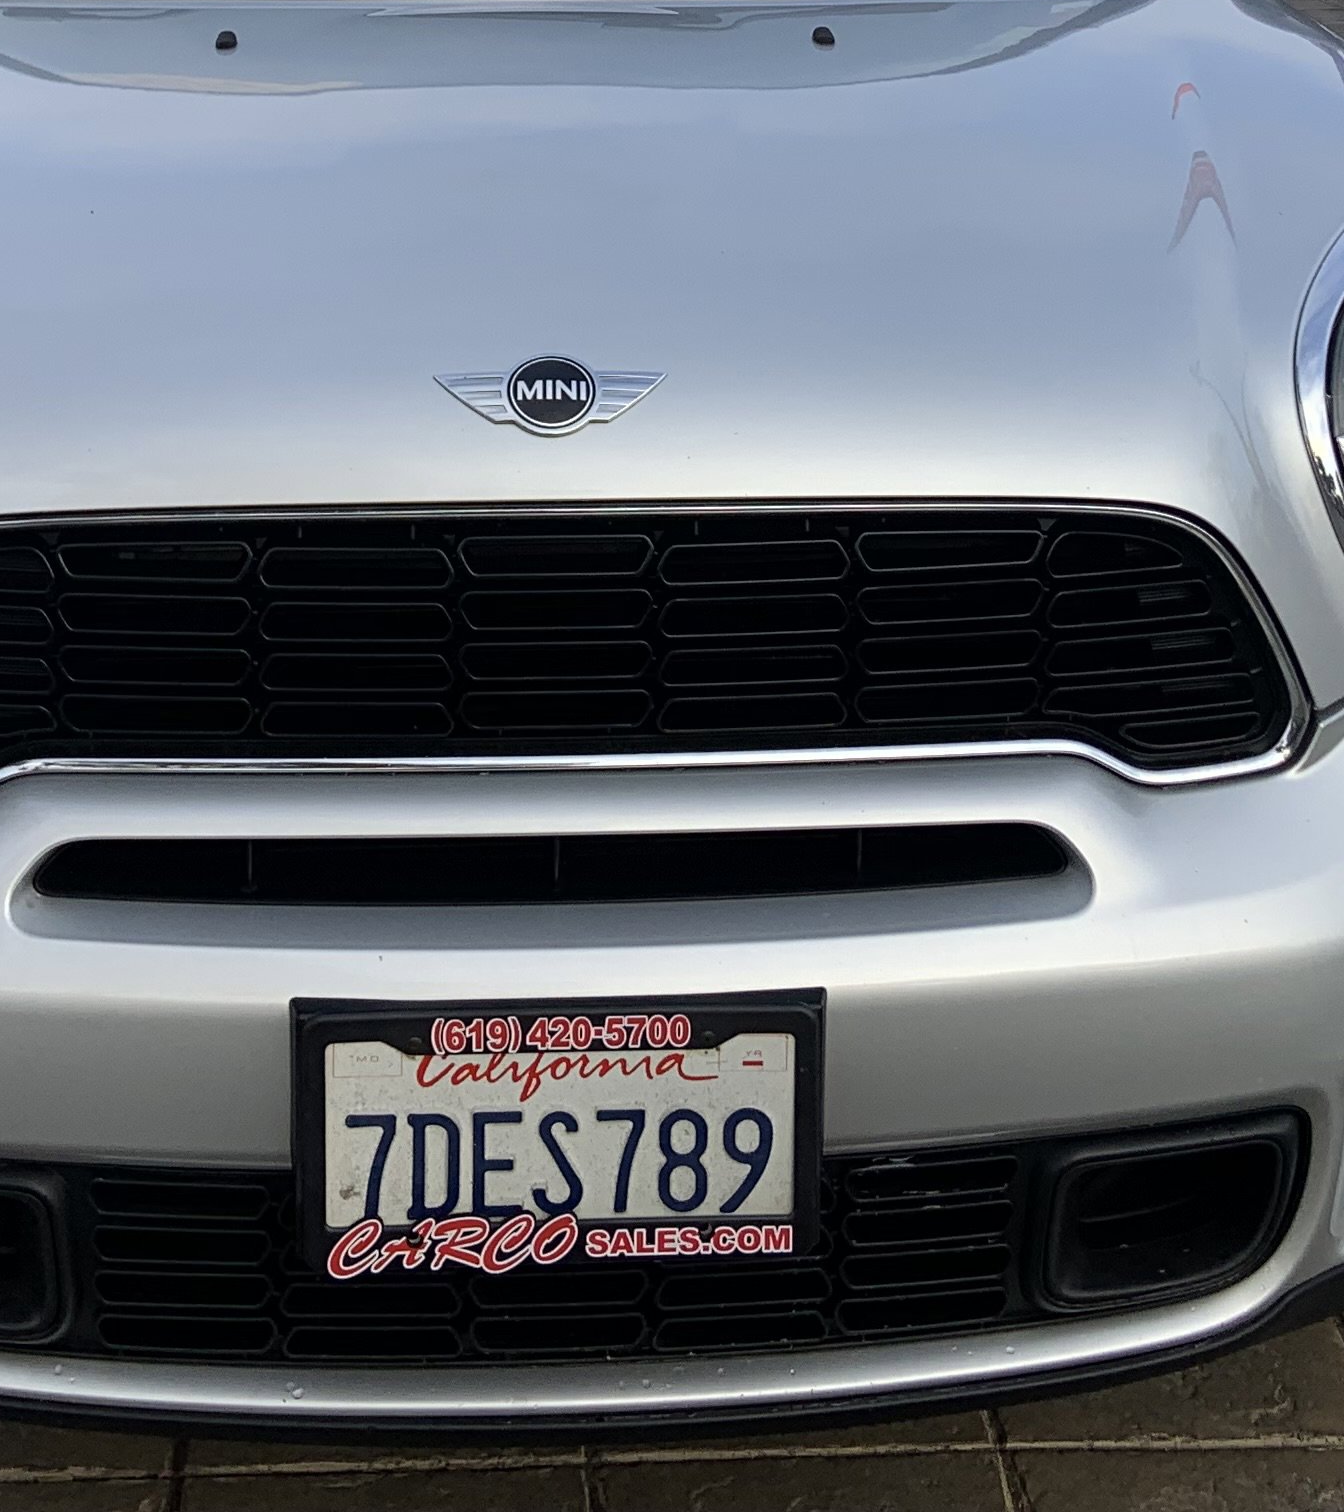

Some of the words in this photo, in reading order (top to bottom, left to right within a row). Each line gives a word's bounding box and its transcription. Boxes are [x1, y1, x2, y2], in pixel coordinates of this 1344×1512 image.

[516, 379, 588, 402] MINI
[431, 1015, 523, 1055] (619)
[526, 1013, 691, 1051] 420-5700
[416, 1052, 719, 1102] California
[344, 1107, 774, 1220] 7DES789
[327, 1214, 579, 1280] CARCO
[586, 1225, 794, 1257] SALES.COM
